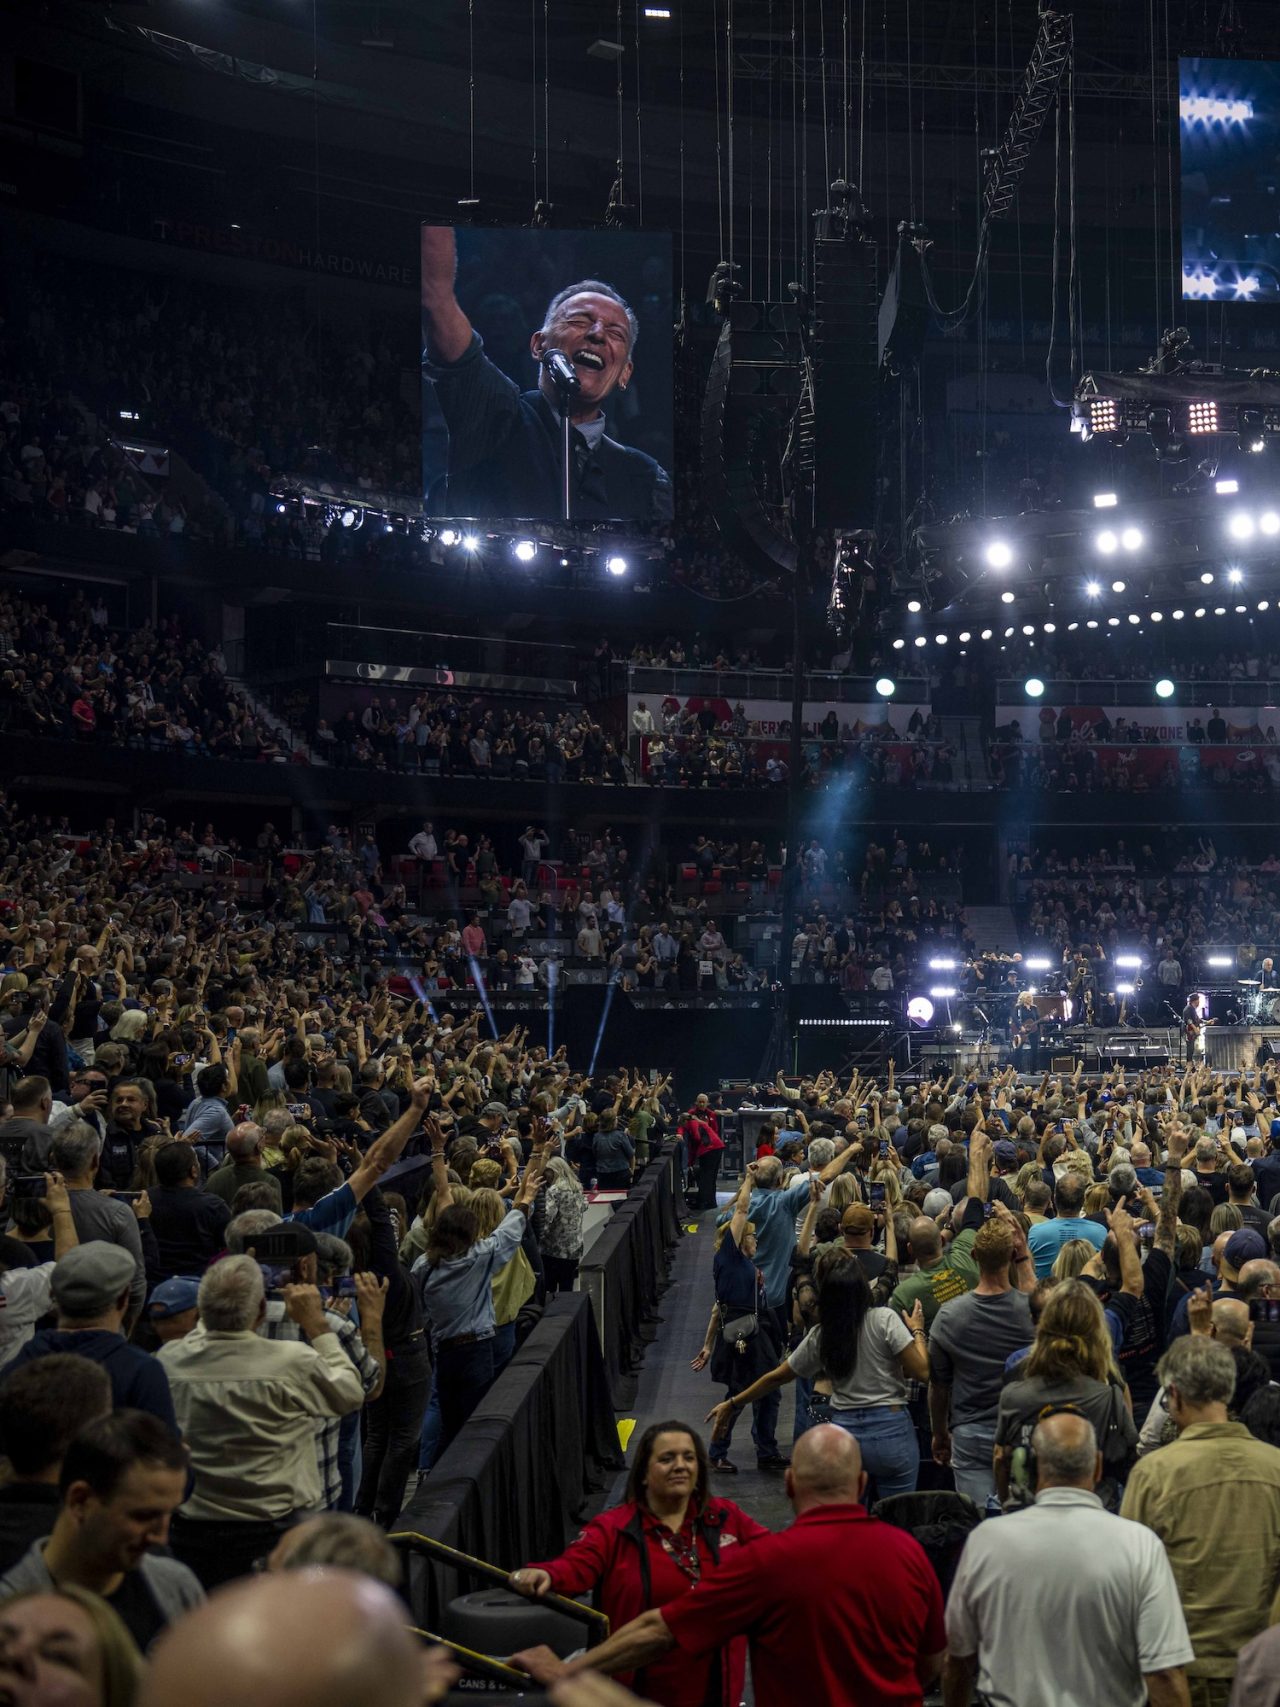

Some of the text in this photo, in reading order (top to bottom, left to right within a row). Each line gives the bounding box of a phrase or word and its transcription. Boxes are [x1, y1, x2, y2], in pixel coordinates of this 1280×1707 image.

[299, 248, 413, 284] HARDWARE
[459, 1678, 486, 1690] CANS
[489, 1680, 496, 1689] &
